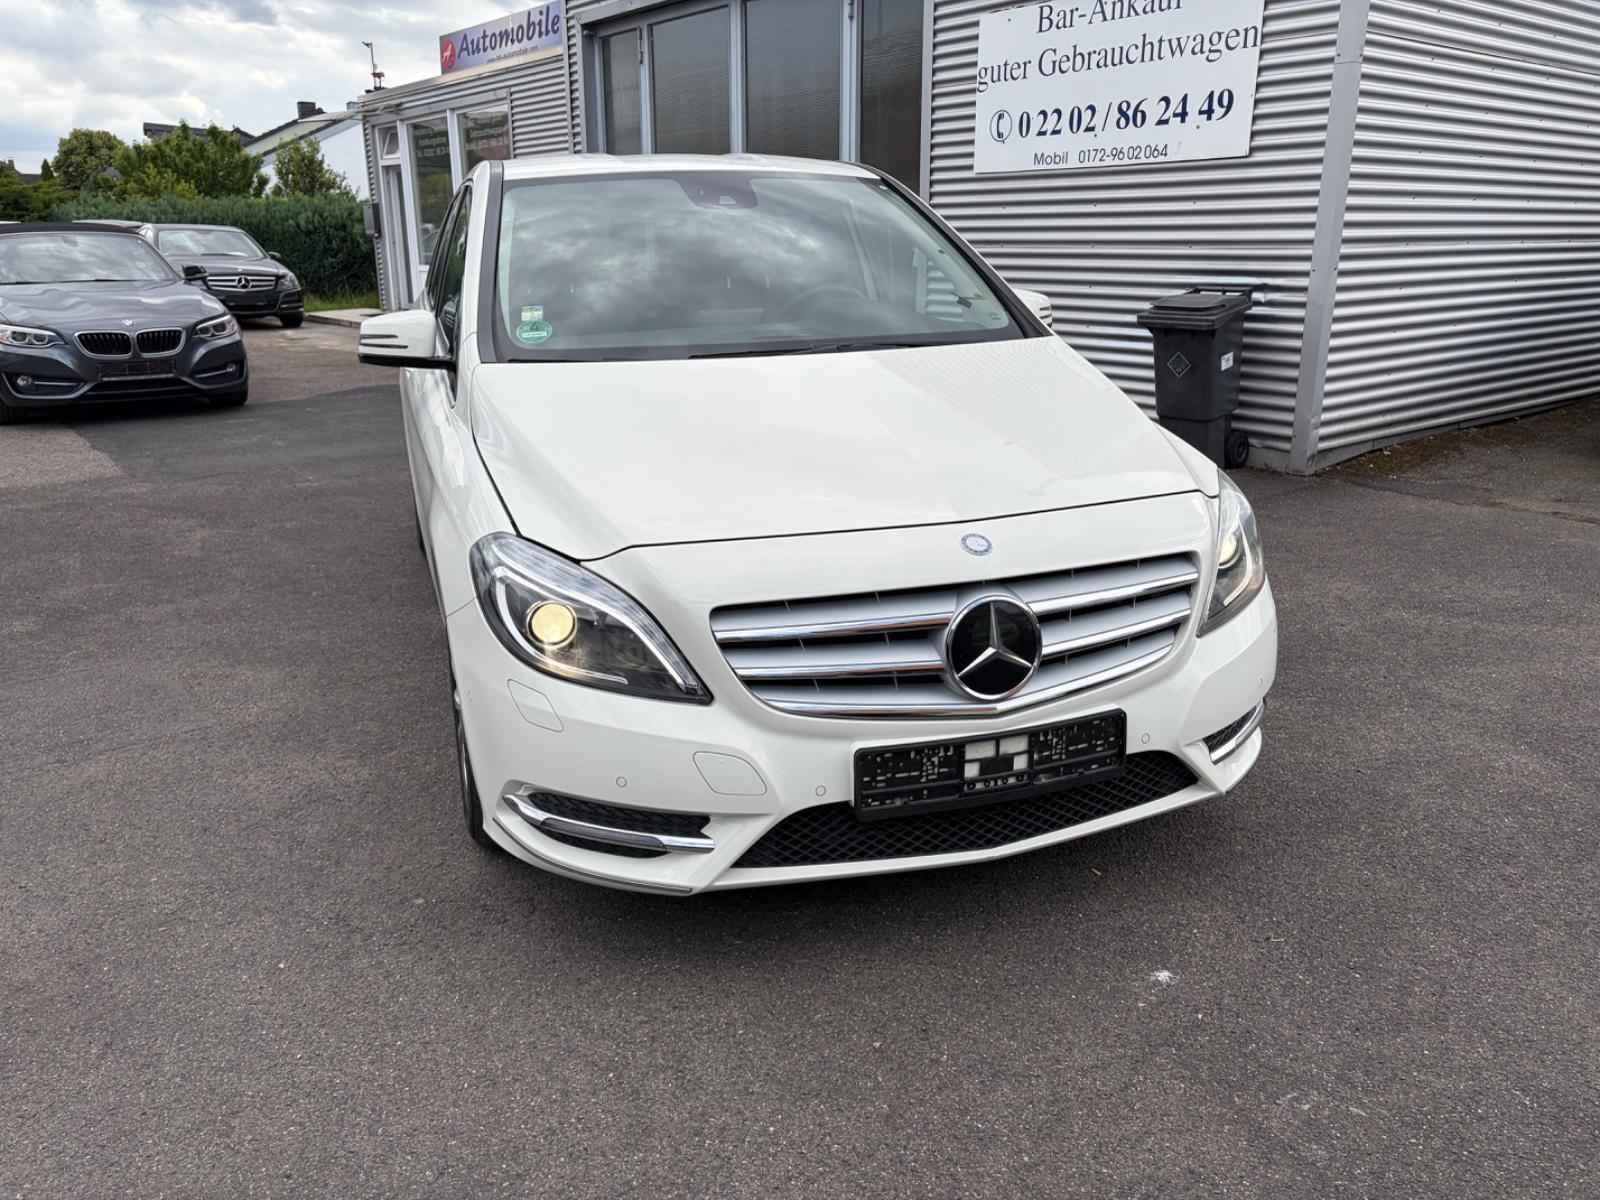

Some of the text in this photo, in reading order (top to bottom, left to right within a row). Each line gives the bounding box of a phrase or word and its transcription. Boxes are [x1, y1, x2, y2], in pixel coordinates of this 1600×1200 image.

[457, 5, 560, 59] Automobile
[976, 24, 1259, 92] guter Gebrauchtwagen
[1033, 150, 1069, 166] Mobil
